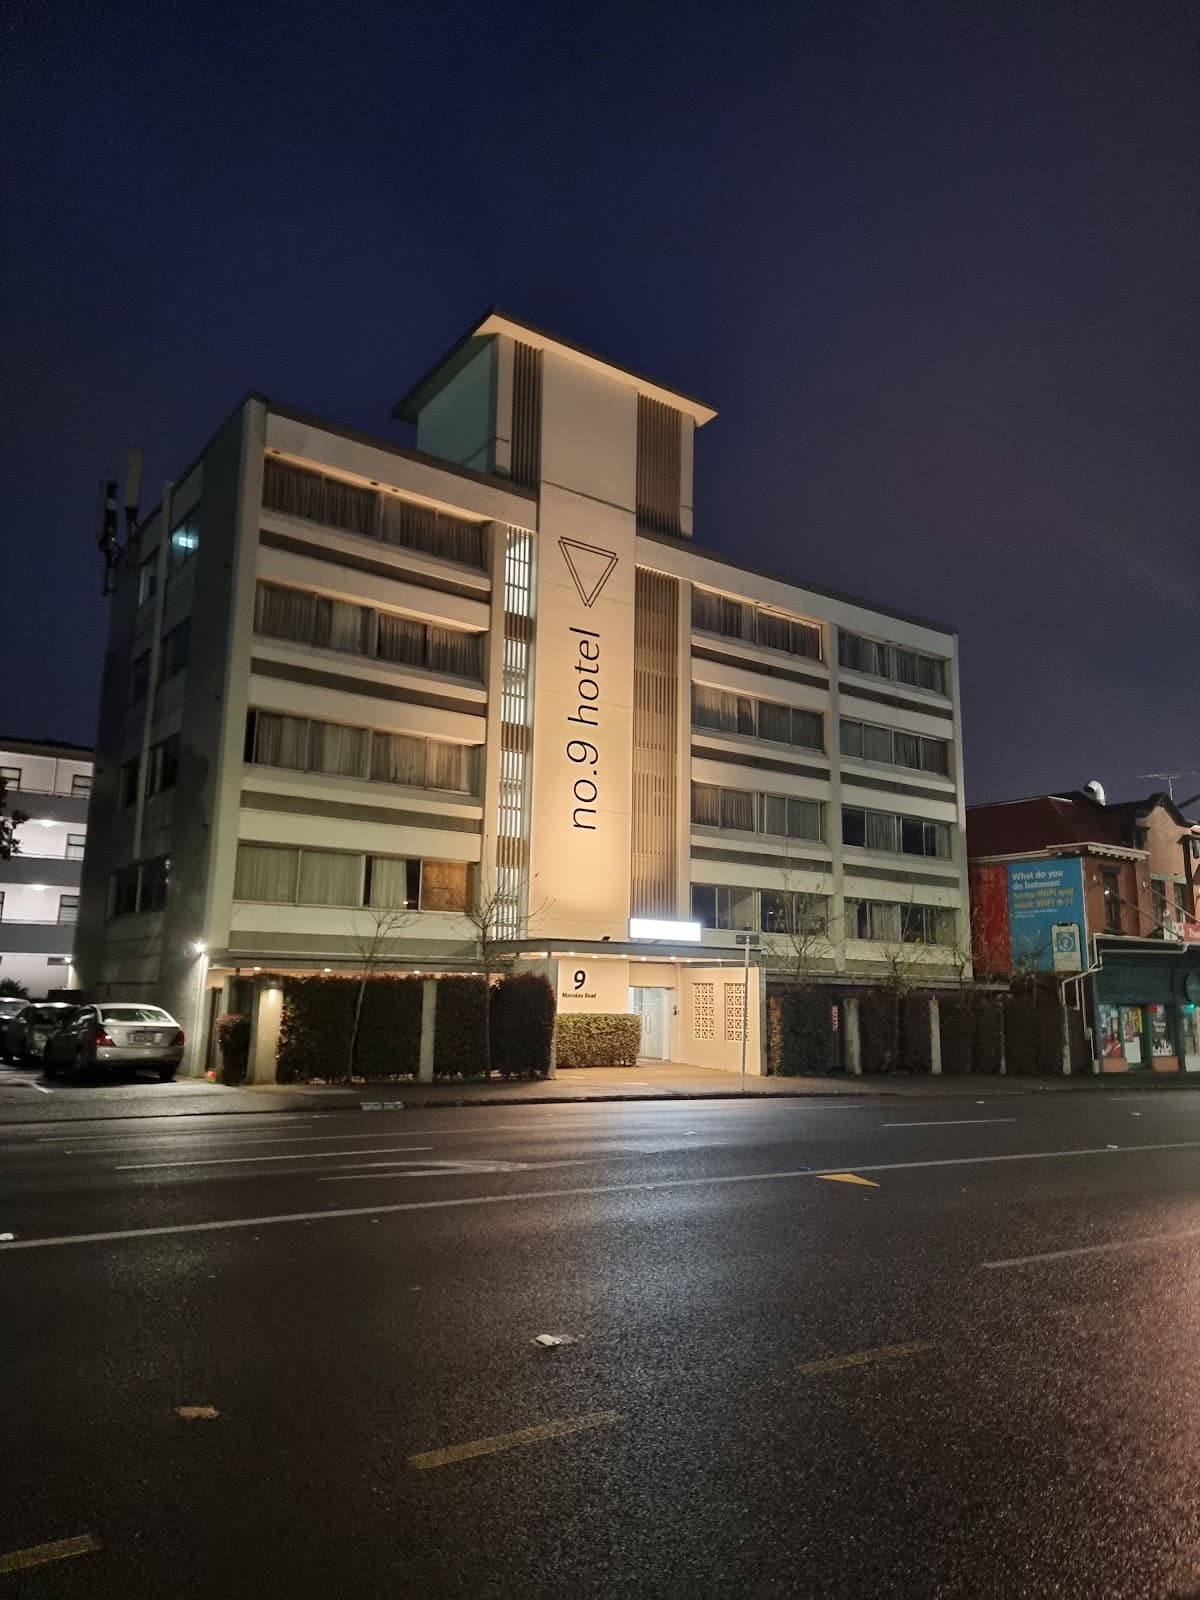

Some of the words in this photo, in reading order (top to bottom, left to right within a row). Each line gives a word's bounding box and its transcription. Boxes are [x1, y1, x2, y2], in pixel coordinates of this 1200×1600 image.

[568, 627, 601, 725] hotel
[567, 740, 599, 830] no.9
[1012, 872, 1033, 880] What
[1035, 870, 1046, 879] do
[1048, 870, 1063, 879] you
[1013, 882, 1023, 890] do
[1025, 880, 1060, 889] between
[574, 970, 586, 990] 9
